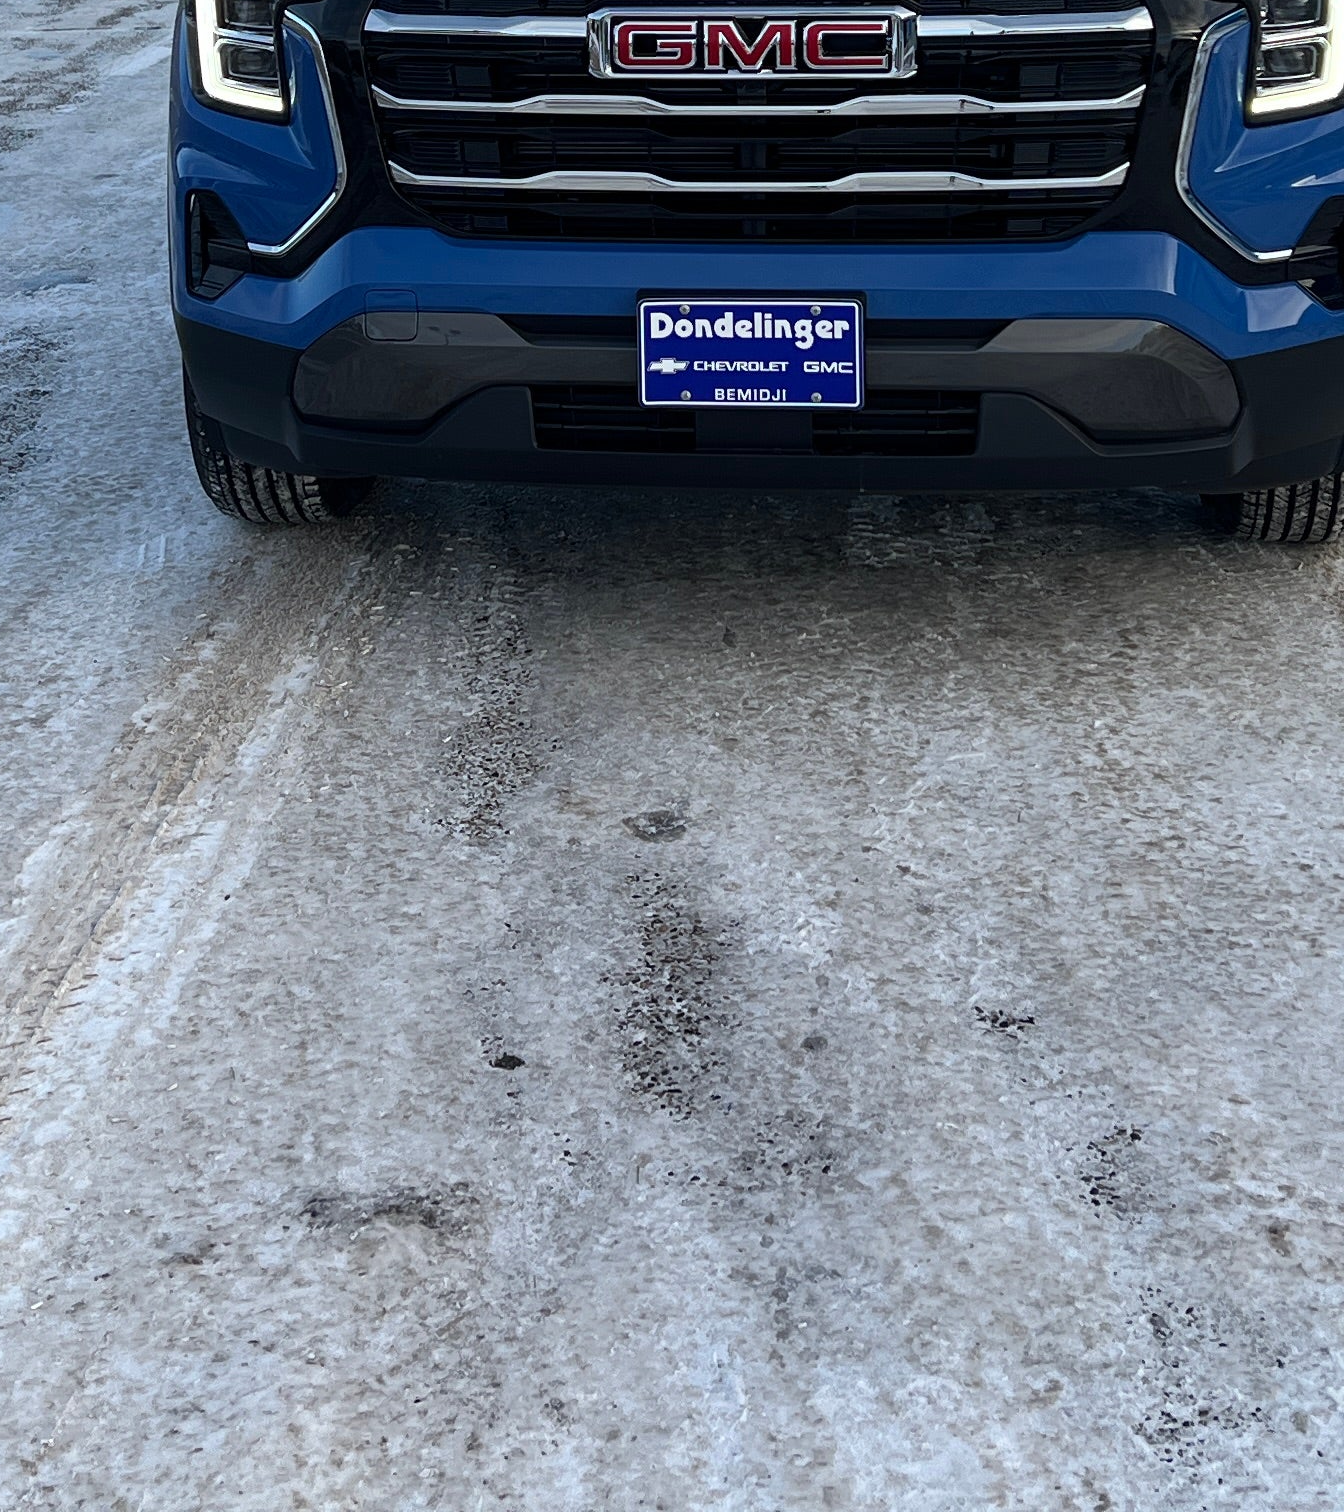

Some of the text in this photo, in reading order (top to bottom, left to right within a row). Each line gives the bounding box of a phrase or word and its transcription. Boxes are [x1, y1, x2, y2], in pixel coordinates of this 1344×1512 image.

[613, 20, 889, 71] GMC
[650, 311, 850, 350] Dondelinger
[693, 360, 854, 374] CHEVROLET GMC
[714, 388, 787, 401] BEMIDJI
